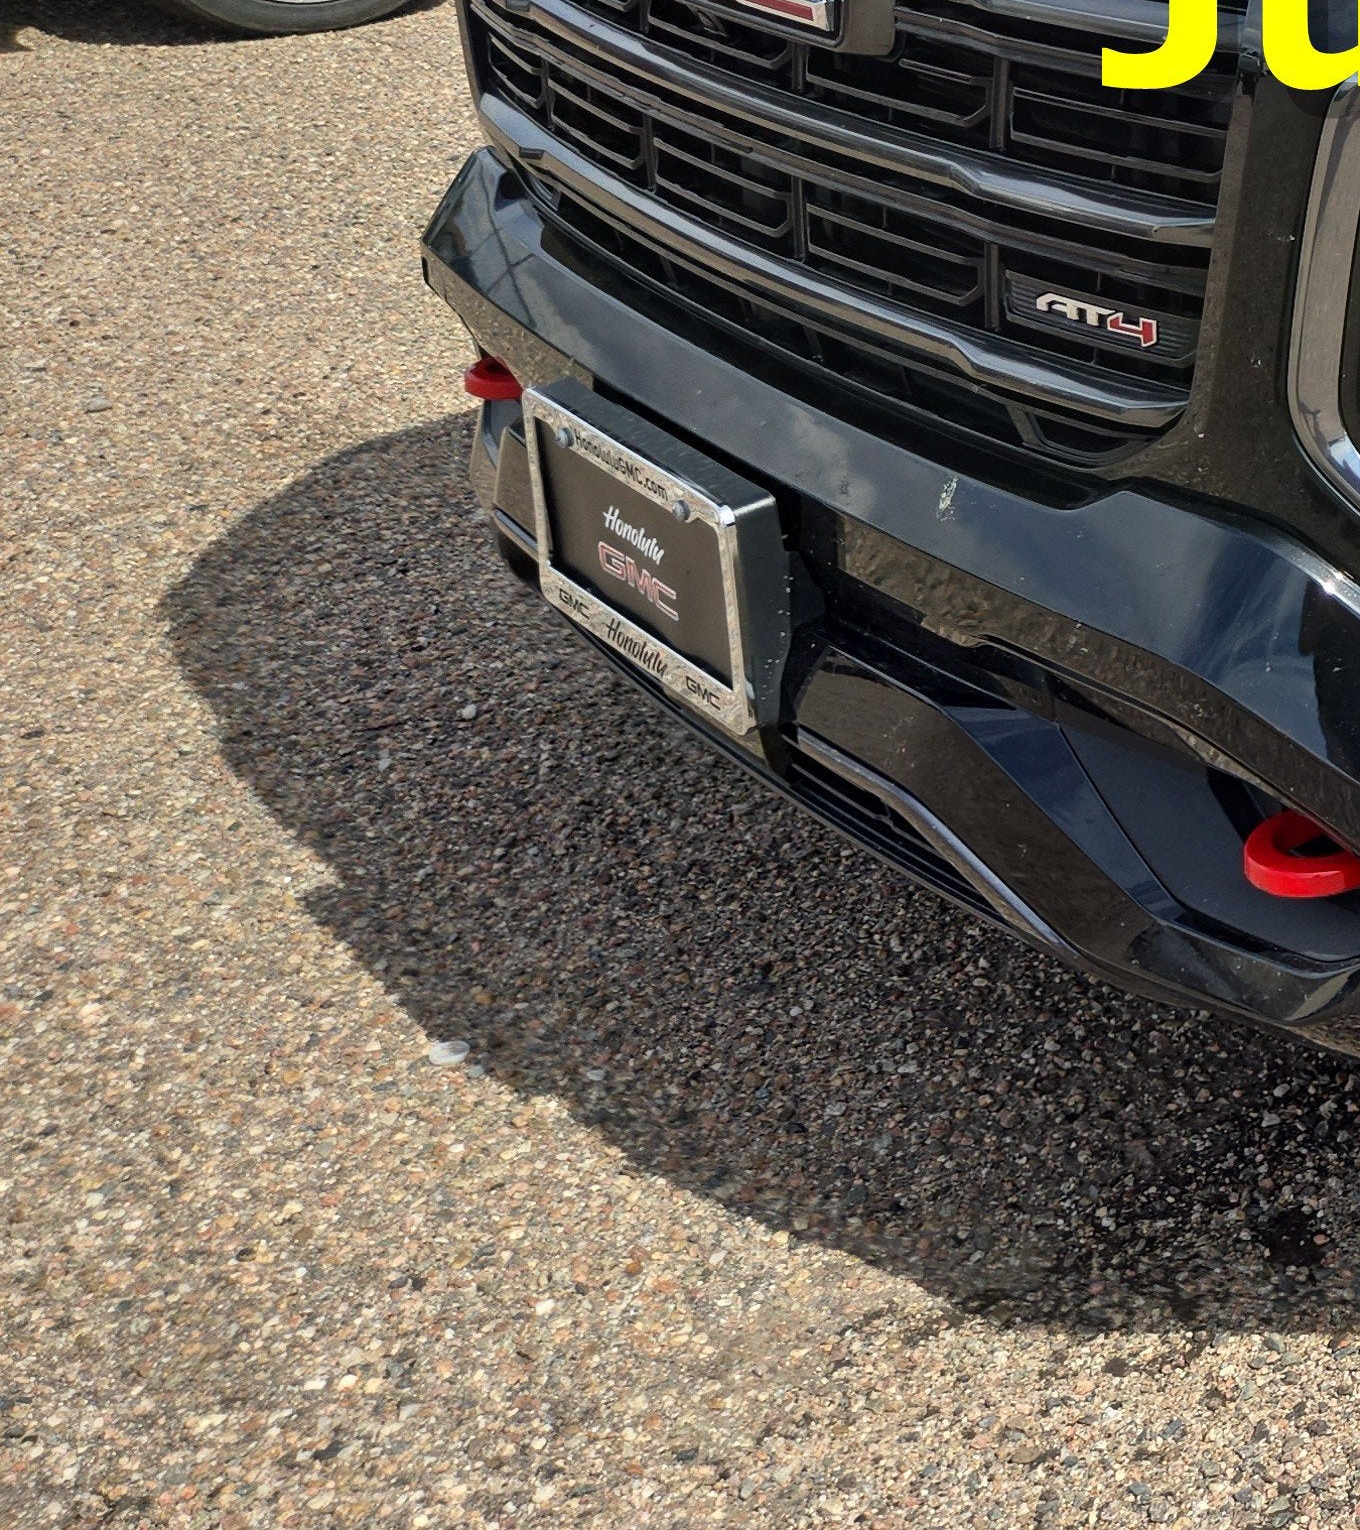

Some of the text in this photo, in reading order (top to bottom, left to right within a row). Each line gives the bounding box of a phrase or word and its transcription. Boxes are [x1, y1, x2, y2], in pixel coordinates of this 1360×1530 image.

[1035, 291, 1160, 349] AT4
[574, 428, 670, 503] HonoluluGMC.com
[603, 505, 666, 566] Honolulu
[598, 540, 680, 622] GMC
[559, 587, 722, 711] GMC Honolulu GMC
